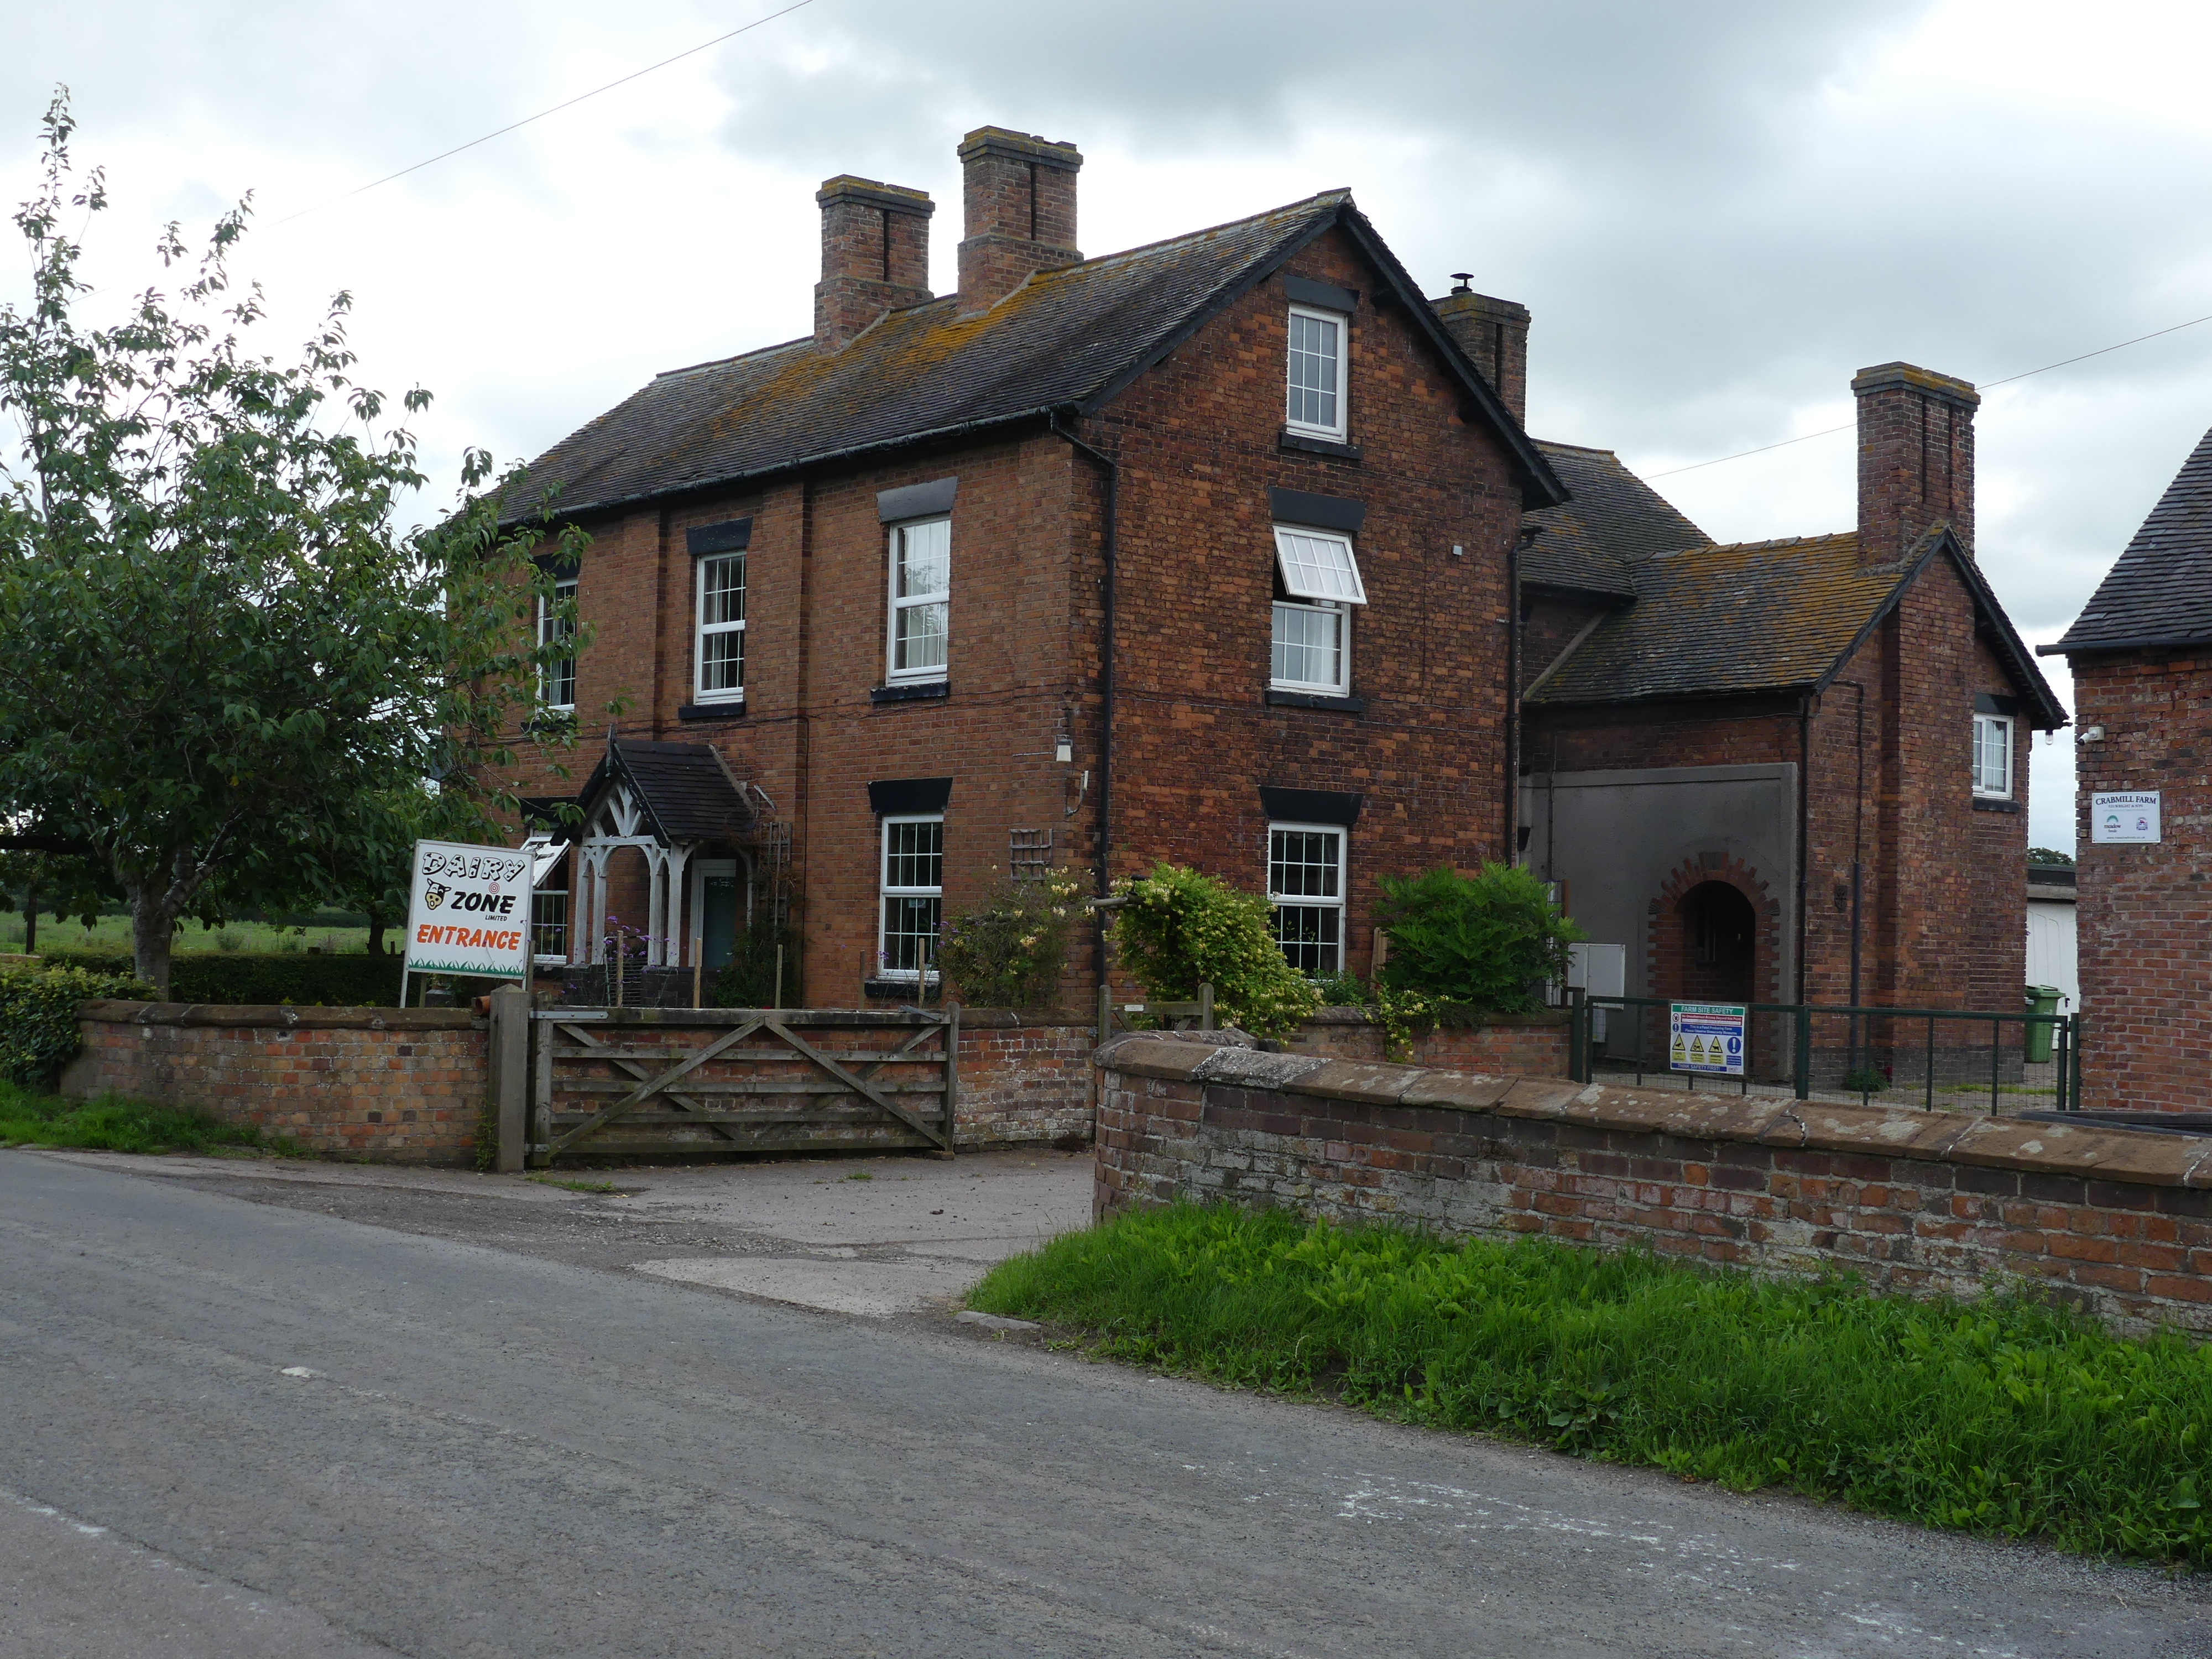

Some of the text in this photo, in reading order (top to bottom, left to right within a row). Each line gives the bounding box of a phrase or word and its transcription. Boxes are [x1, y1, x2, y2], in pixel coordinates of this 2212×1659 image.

[2096, 796, 2156, 805] CRABMILL FARM
[422, 852, 525, 881] DAIRY
[451, 891, 516, 914] ZONE
[416, 924, 521, 950] ENTRANCE
